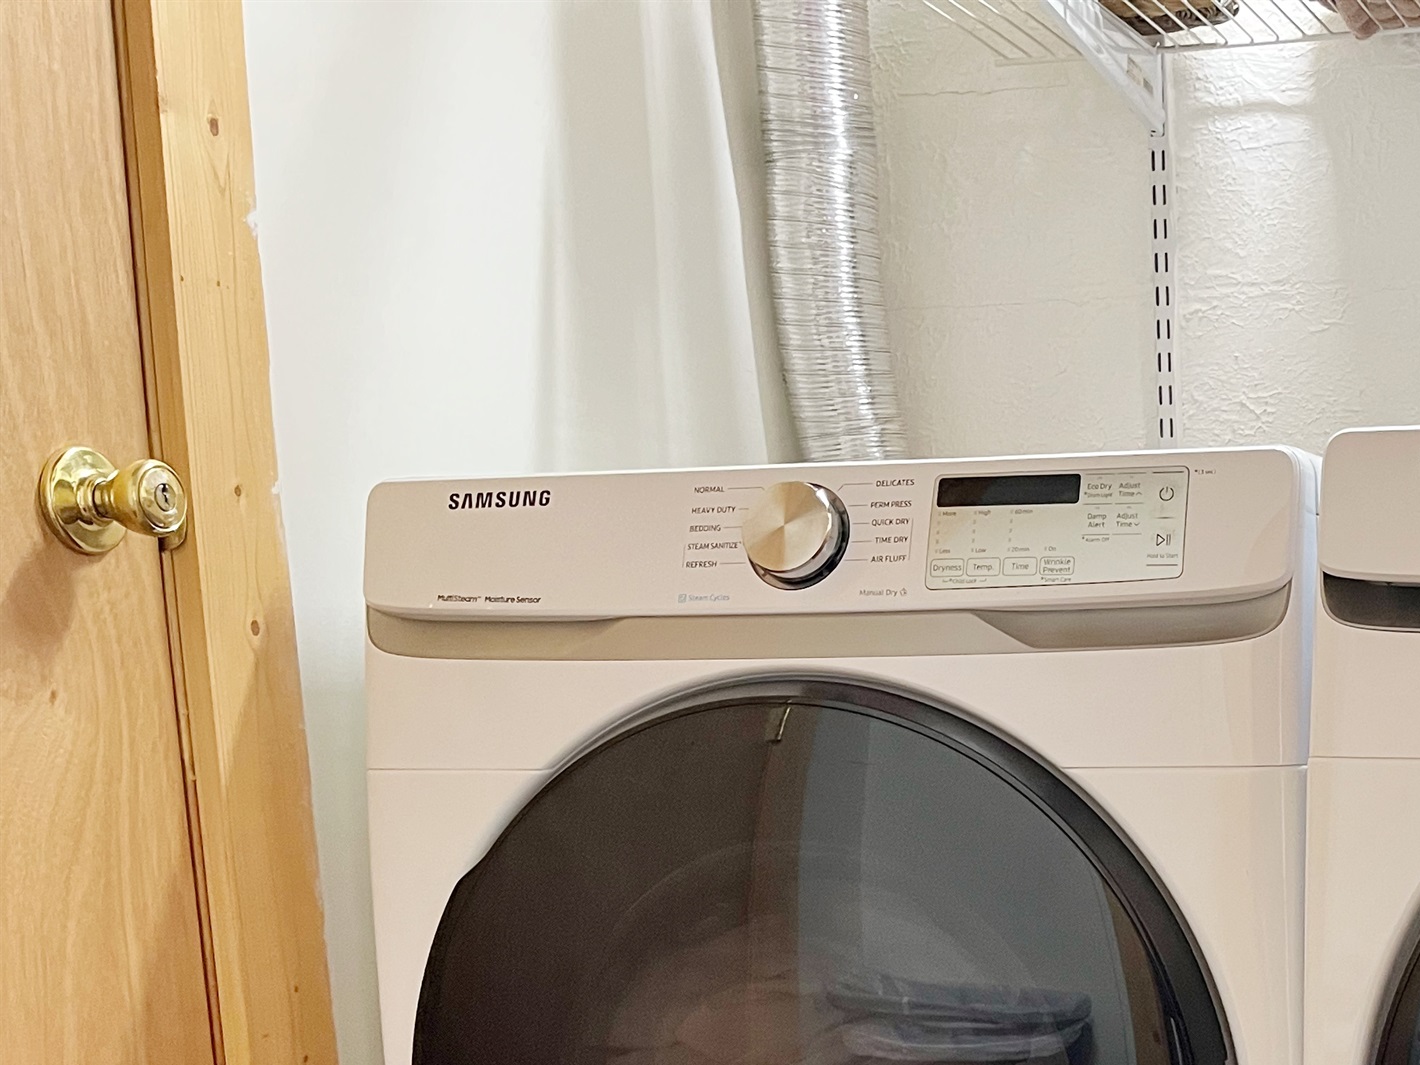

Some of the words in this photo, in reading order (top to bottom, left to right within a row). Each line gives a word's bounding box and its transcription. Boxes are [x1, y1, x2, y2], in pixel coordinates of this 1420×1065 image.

[876, 479, 915, 487] DELICATES
[1100, 483, 1112, 491] Dry
[1119, 482, 1141, 490] Adjust
[694, 486, 725, 494] NORMAL
[448, 490, 551, 510] SAMSUNG
[891, 500, 912, 508] PRESS
[716, 506, 736, 514] DUTY
[1087, 513, 1107, 521] Damp
[686, 560, 718, 568] REFRESH
[1012, 562, 1030, 570] Time
[1043, 558, 1072, 566] Wrinkle
[932, 564, 962, 573] Dryness
[973, 563, 994, 572] Temp.
[1043, 566, 1071, 574] Prevent
[886, 588, 898, 598] Dry
[709, 594, 730, 602] Cycles
